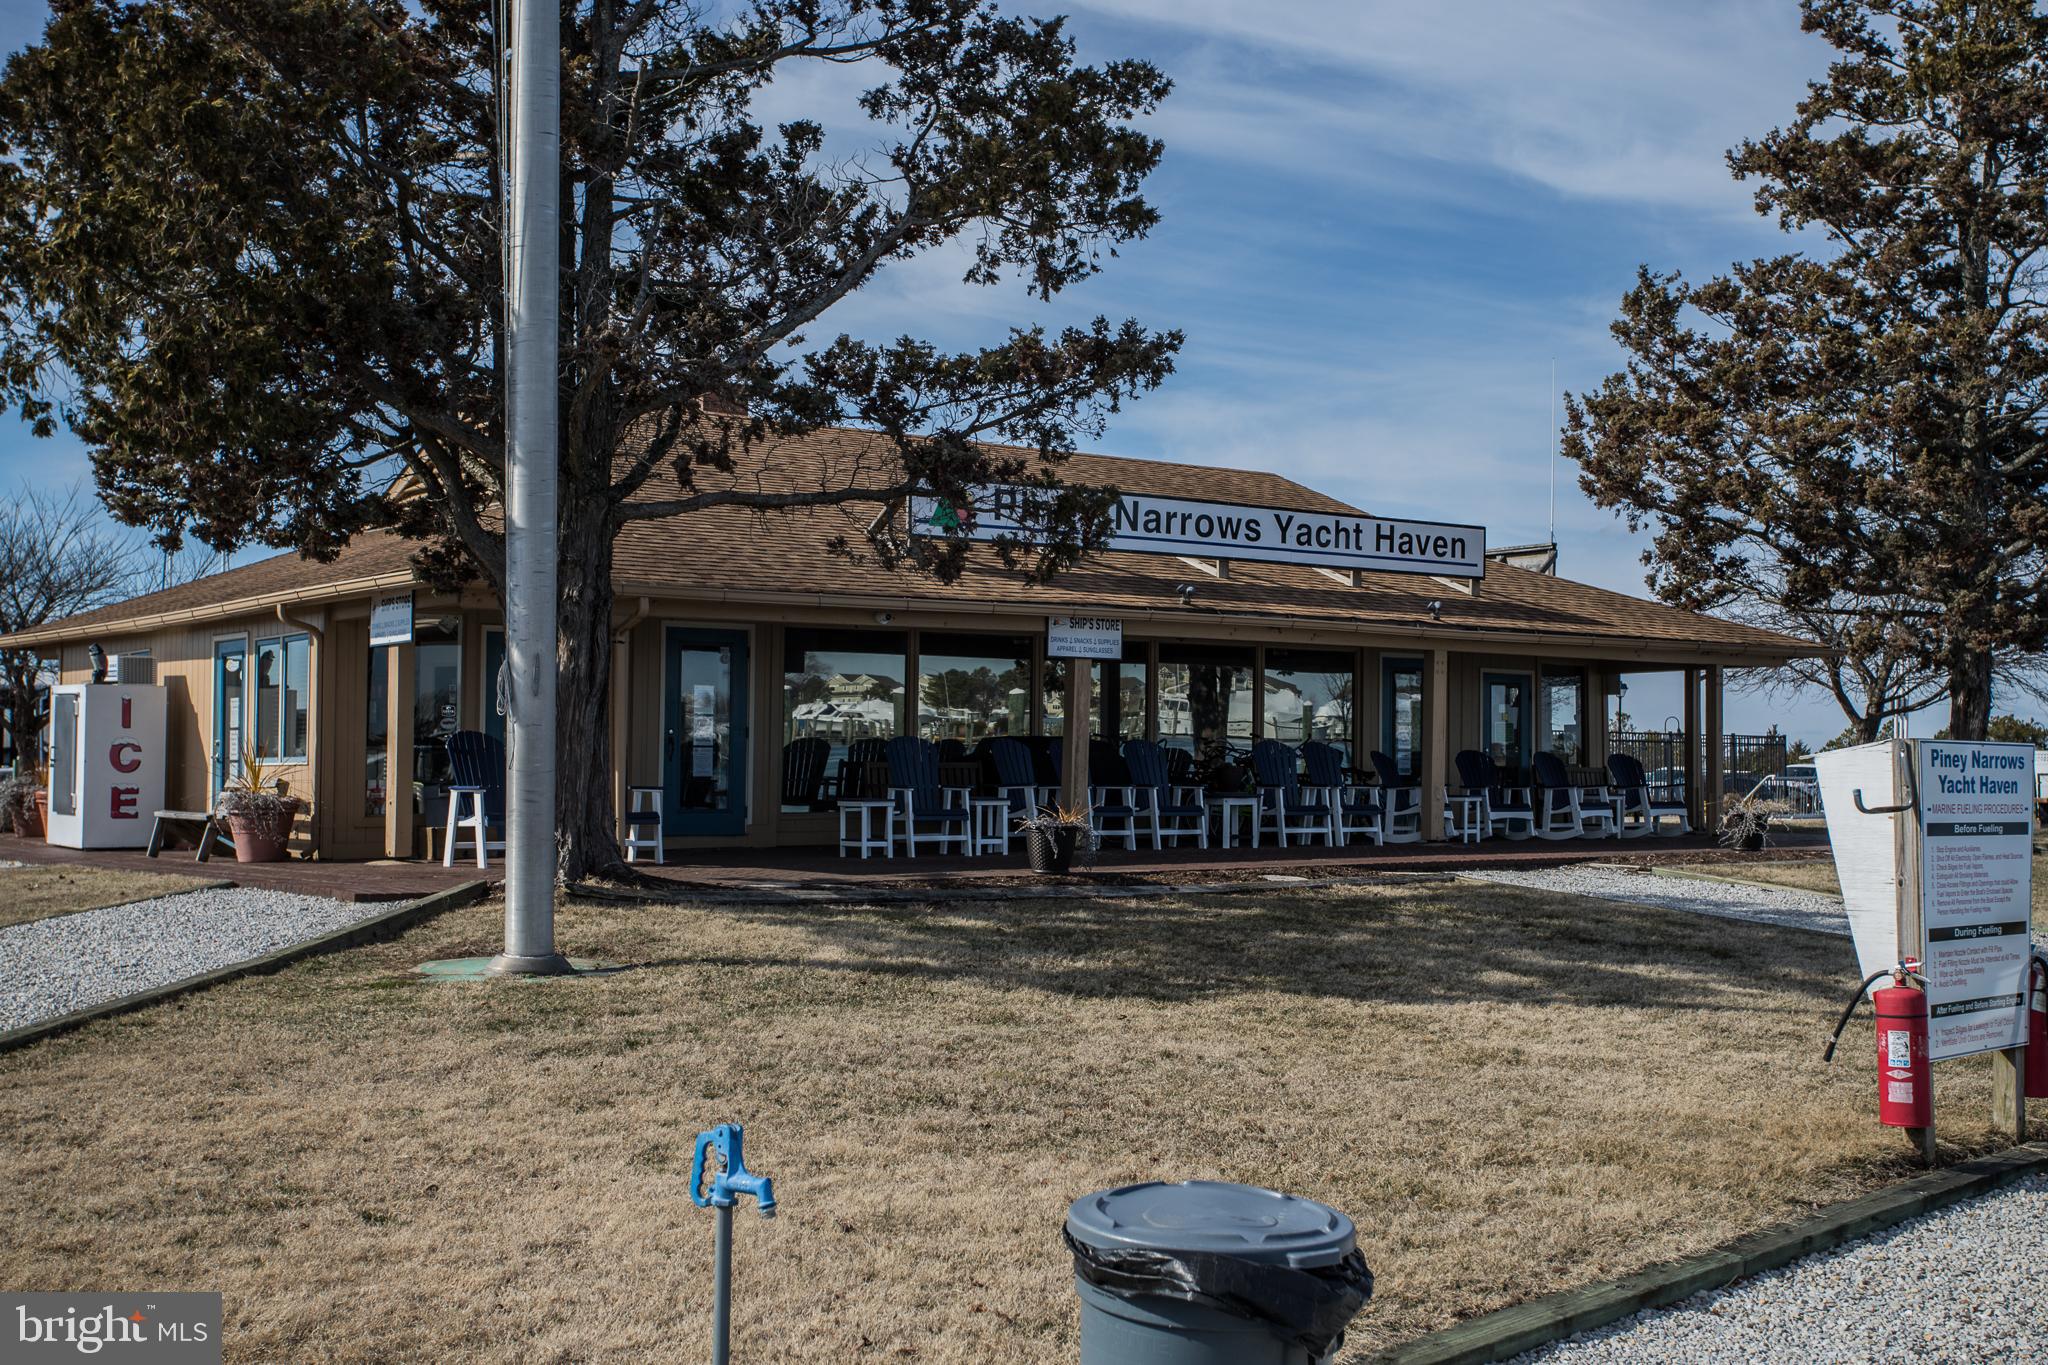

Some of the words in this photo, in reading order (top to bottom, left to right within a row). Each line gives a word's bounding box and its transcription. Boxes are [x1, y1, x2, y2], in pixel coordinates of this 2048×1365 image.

[1115, 499, 1262, 543] Narrows
[1274, 513, 1364, 552] Yacht
[1375, 523, 1468, 560] Haven
[1069, 616, 1093, 630] SHIP'S
[1096, 617, 1120, 631] STORE
[109, 693, 142, 819] ICE
[1930, 748, 1967, 773] Piney
[1971, 750, 2025, 770] Narrows
[1938, 774, 1975, 794] Yacht
[1979, 775, 2018, 794] Haven
[1932, 803, 1957, 814] MARINE
[1957, 803, 1983, 814] FUELING
[1984, 803, 2024, 814] PROCEDURES
[1954, 824, 1978, 833] Before
[1978, 824, 2003, 834] Fueling
[1954, 928, 1977, 938] During
[1978, 926, 2002, 936] Fueling
